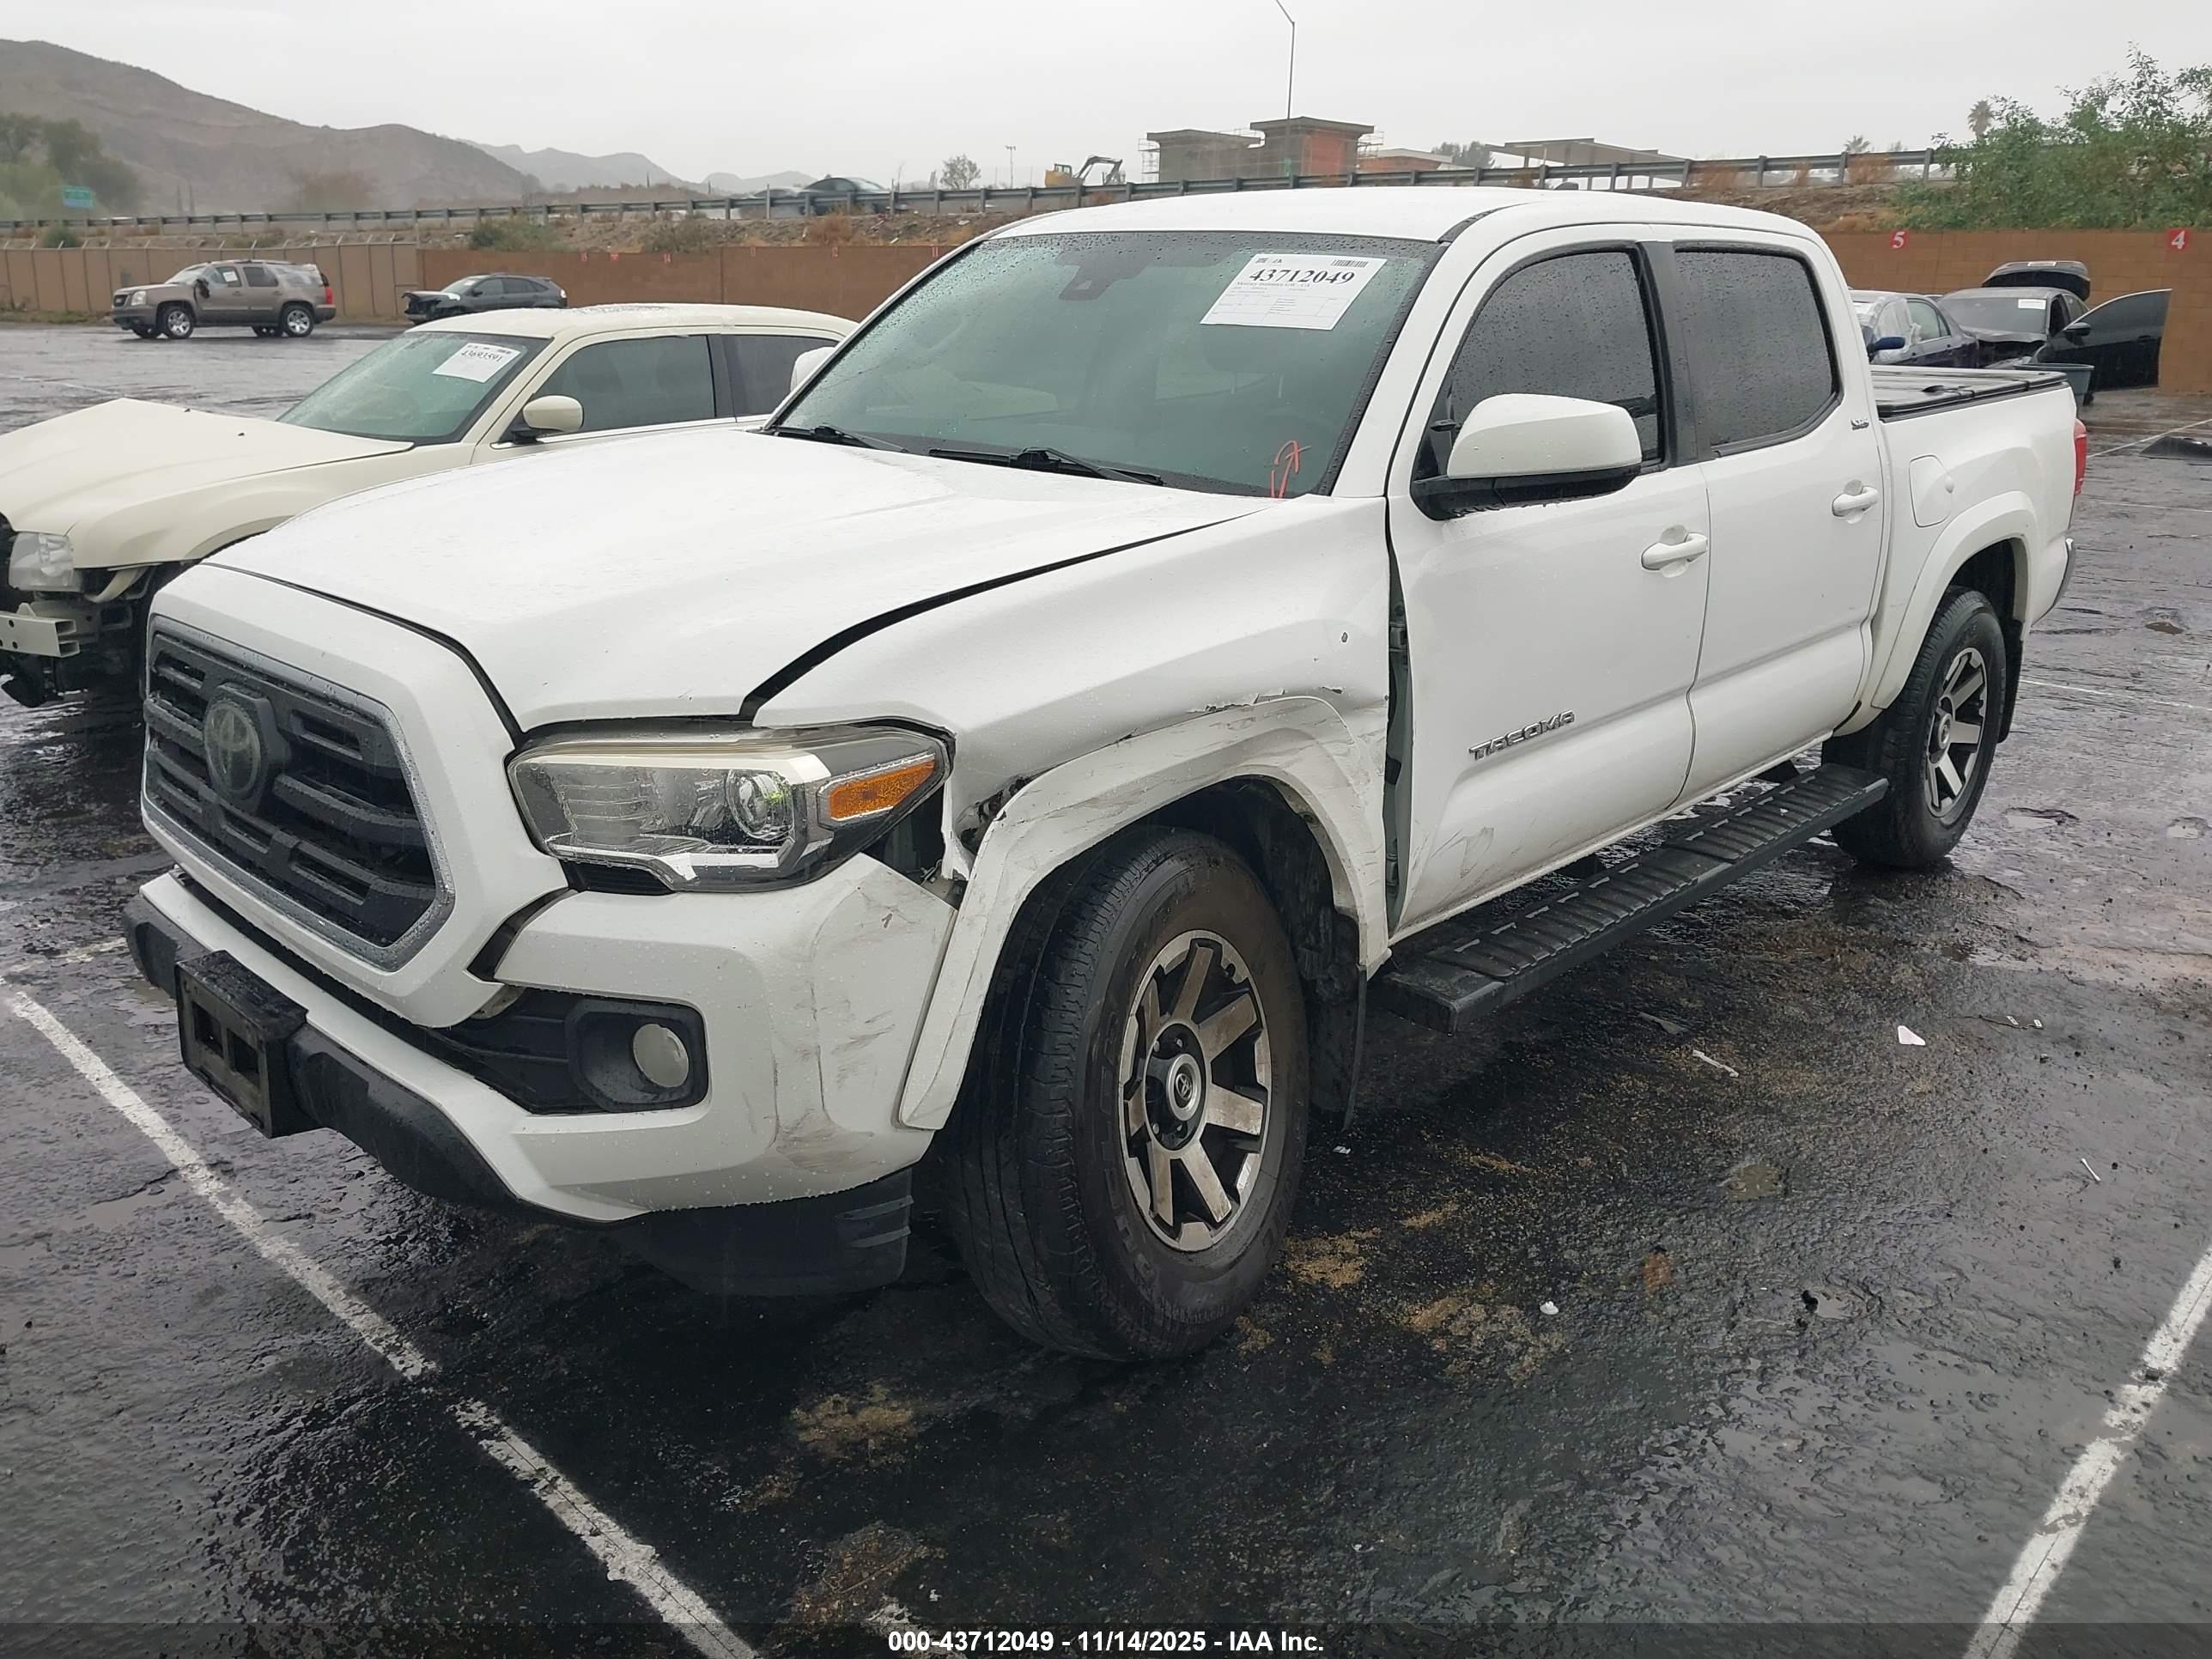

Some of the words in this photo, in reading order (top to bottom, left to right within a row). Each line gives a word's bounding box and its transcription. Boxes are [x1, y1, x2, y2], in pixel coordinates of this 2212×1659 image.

[1893, 231, 1905, 248] 5
[2171, 230, 2185, 249] 4
[1249, 268, 1355, 284] 43712049
[1469, 709, 1575, 761] TACOMA
